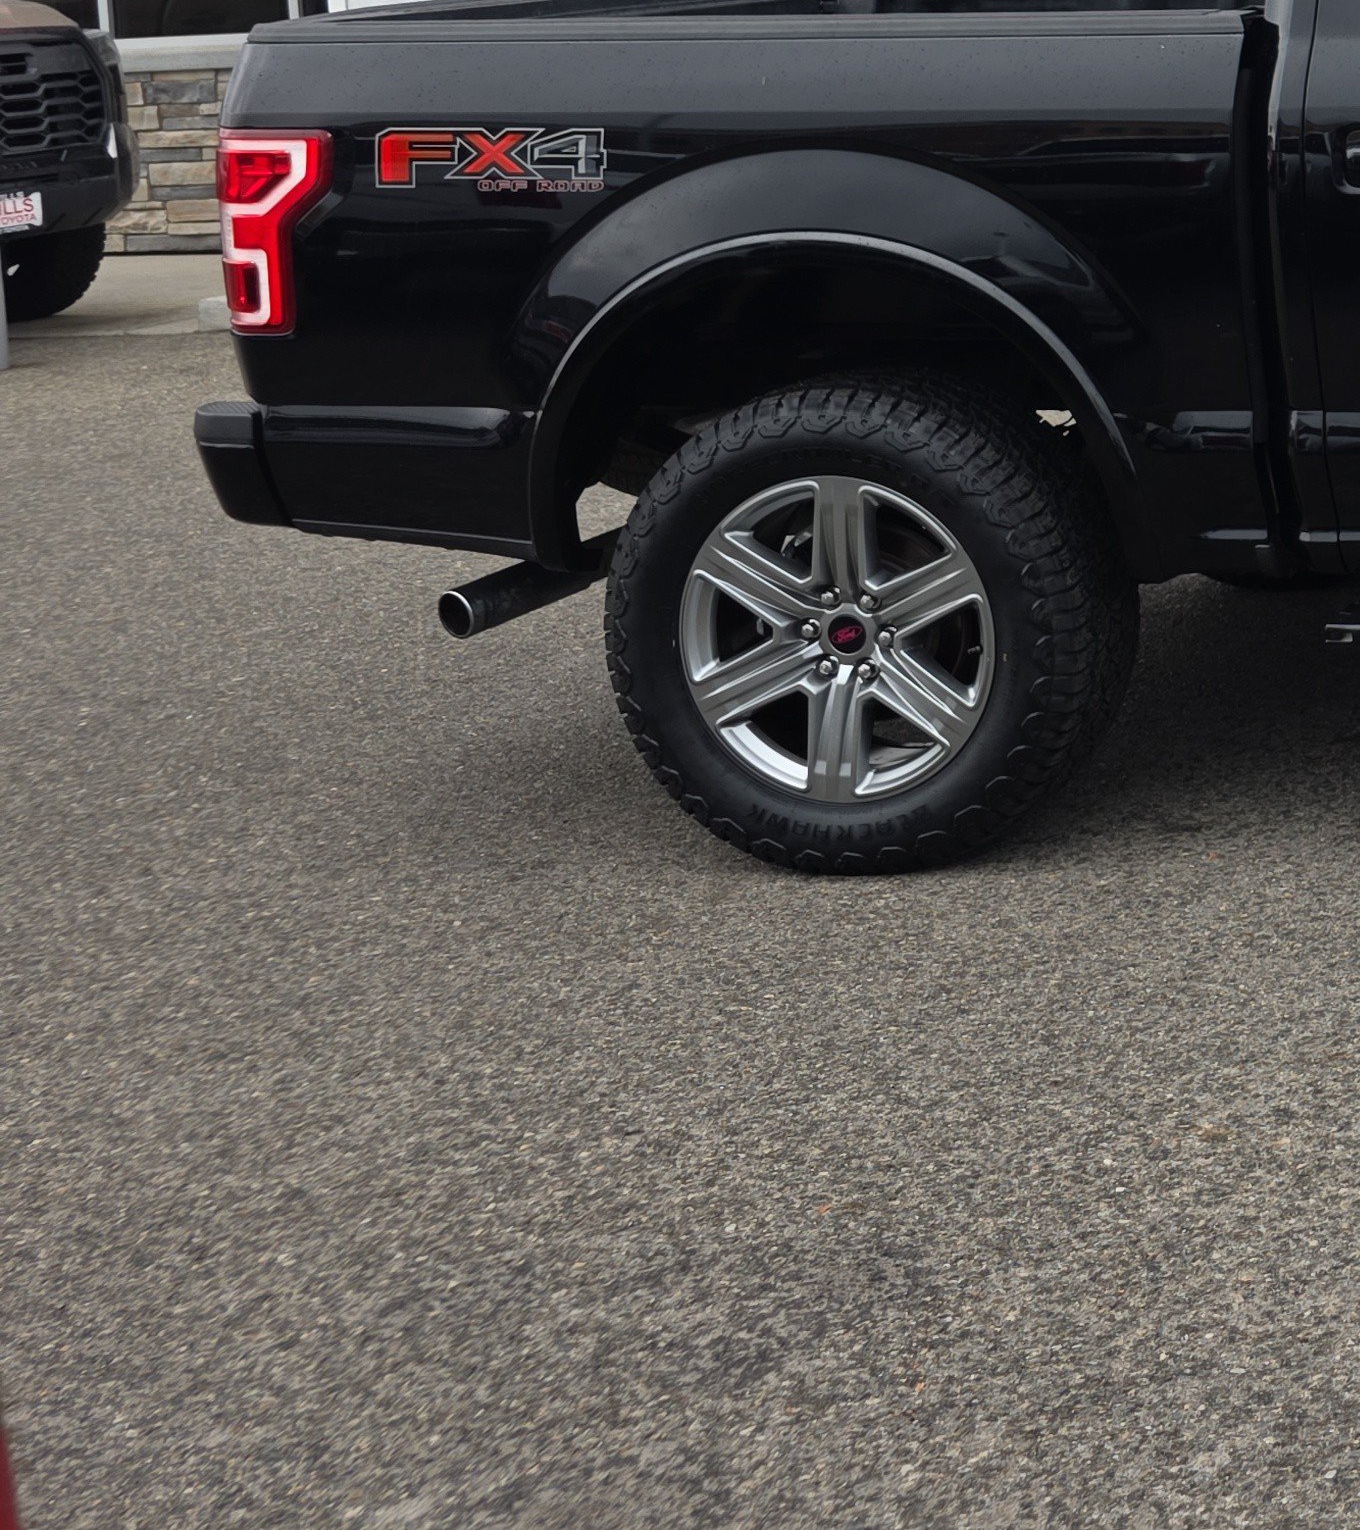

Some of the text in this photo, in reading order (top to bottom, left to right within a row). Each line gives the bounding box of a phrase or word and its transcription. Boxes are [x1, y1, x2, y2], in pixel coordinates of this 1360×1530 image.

[375, 127, 608, 188] FX4
[477, 179, 605, 192] OFF ROAD
[0, 213, 37, 226] OYOTA
